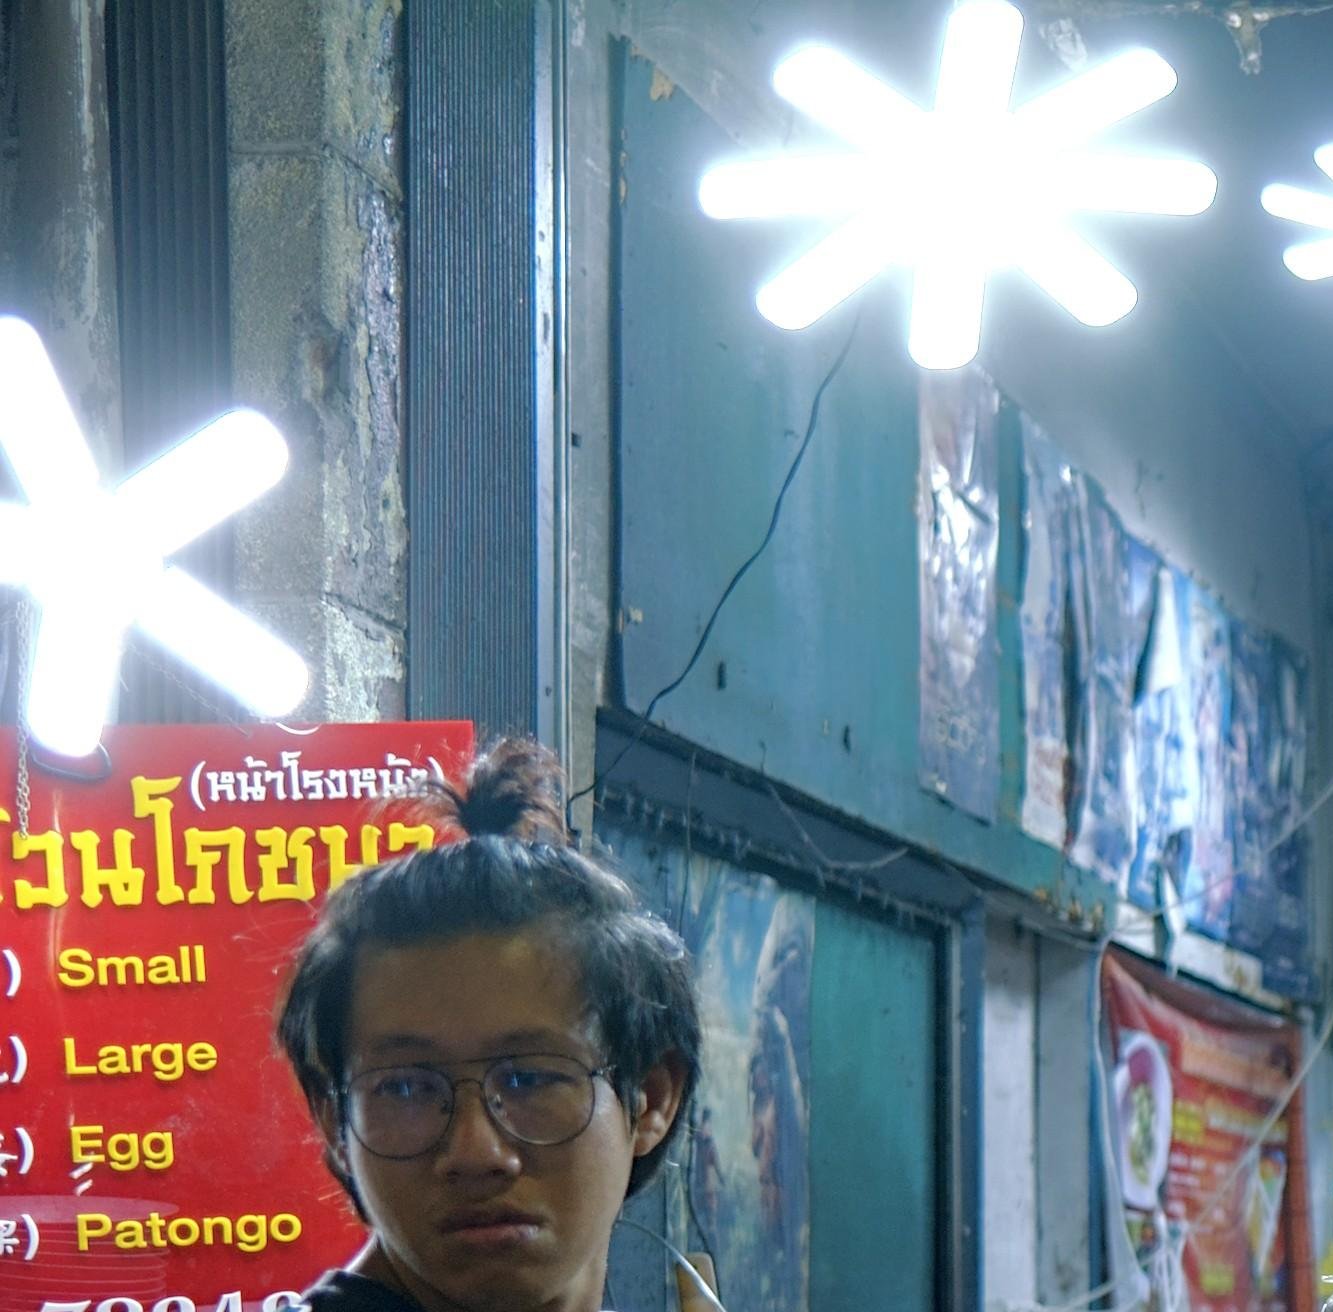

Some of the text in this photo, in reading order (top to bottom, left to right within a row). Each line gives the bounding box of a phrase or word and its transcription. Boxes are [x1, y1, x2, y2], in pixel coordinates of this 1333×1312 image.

[57, 944, 207, 989] Small
[64, 1037, 219, 1083] Large
[70, 1125, 175, 1171] Egg
[76, 1208, 303, 1254] Patongo
